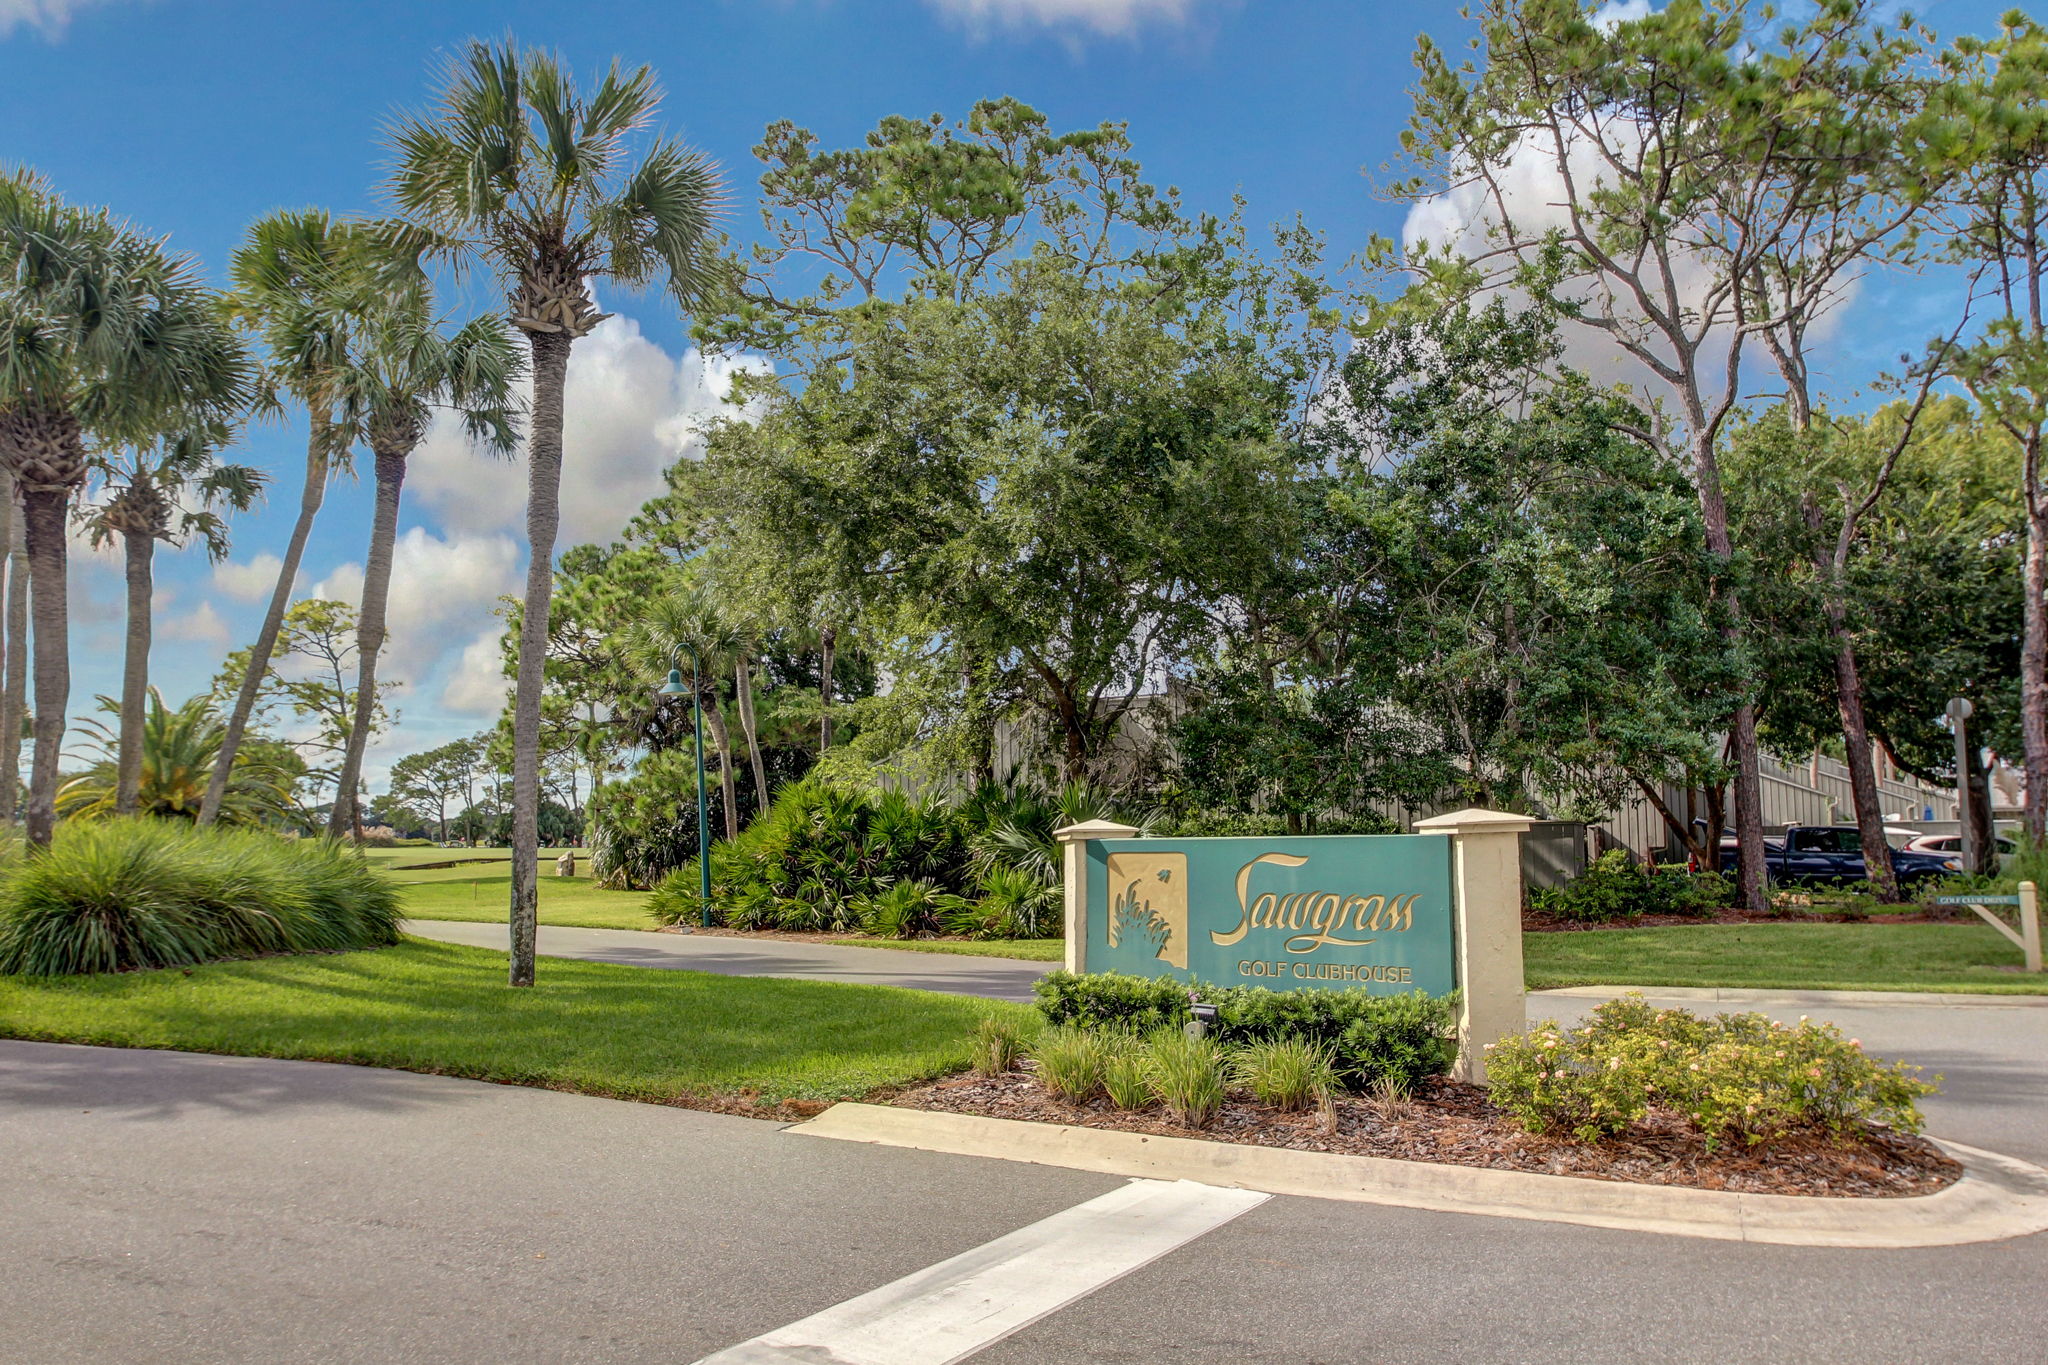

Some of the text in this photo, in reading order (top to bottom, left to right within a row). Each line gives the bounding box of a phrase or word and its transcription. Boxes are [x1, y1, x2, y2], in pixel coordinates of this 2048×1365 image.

[1210, 851, 1422, 954] Sawgrass
[1238, 959, 1413, 984] GOLF CLUBHOUSE
